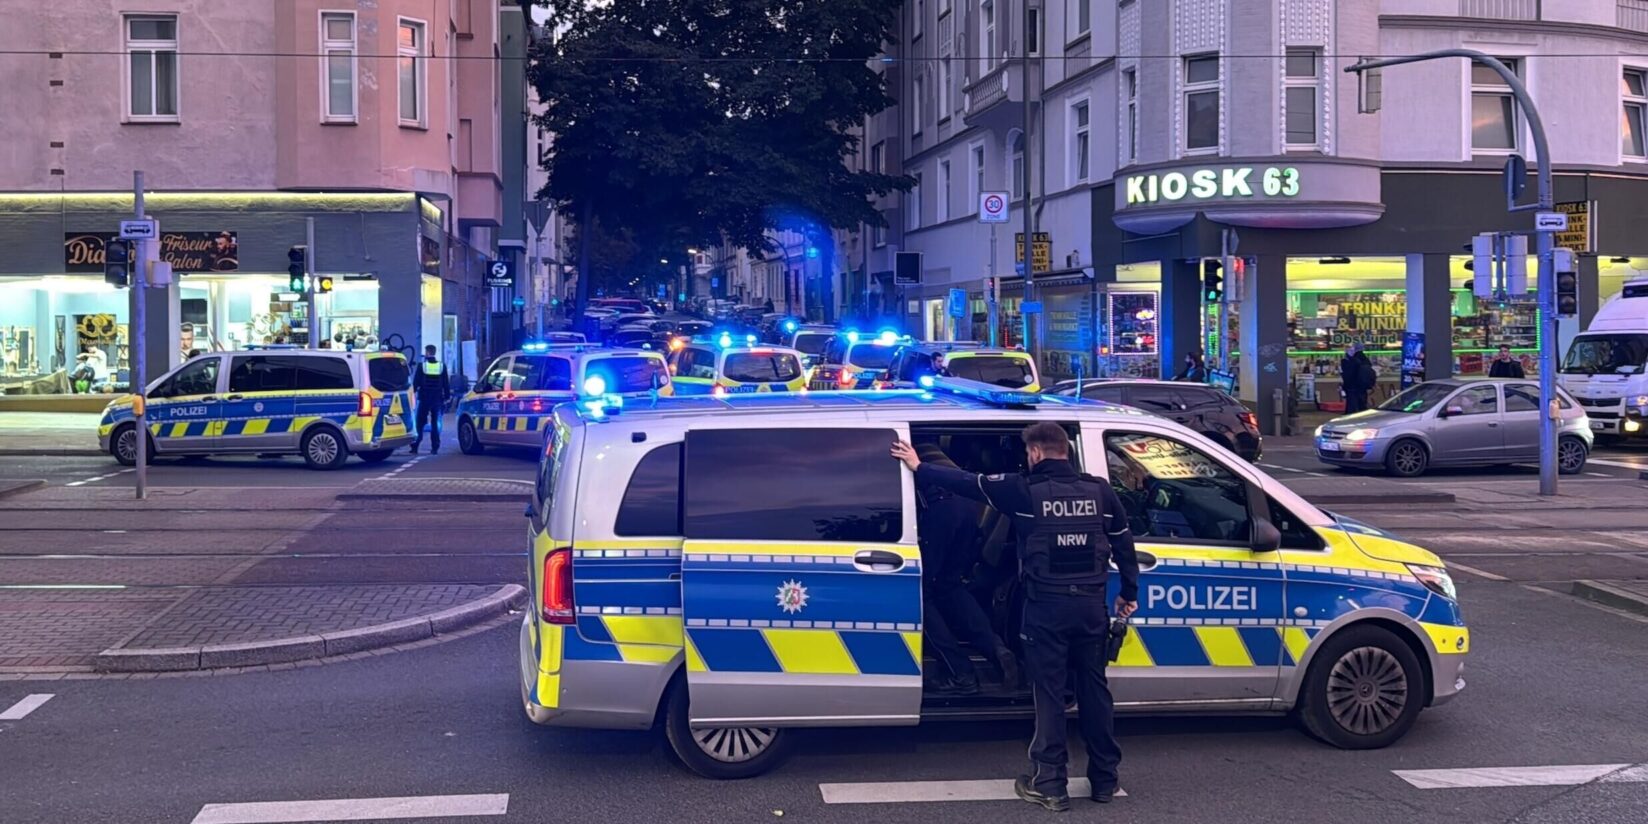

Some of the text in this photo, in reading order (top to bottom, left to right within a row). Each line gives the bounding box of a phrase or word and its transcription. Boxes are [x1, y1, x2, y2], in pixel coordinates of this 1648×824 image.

[1127, 167, 1299, 204] KIOSK 63
[988, 200, 1000, 209] 30
[163, 234, 212, 251] Friseur
[163, 253, 203, 269] Salon
[1337, 318, 1349, 330] &
[1334, 333, 1368, 344] Obst
[1371, 333, 1397, 344] und
[1404, 359, 1422, 367] MAX
[170, 406, 207, 416] POLIZEI
[1042, 499, 1098, 517] POLIZEI
[1057, 534, 1088, 547] NRW
[1147, 585, 1257, 610] POLIZEI
